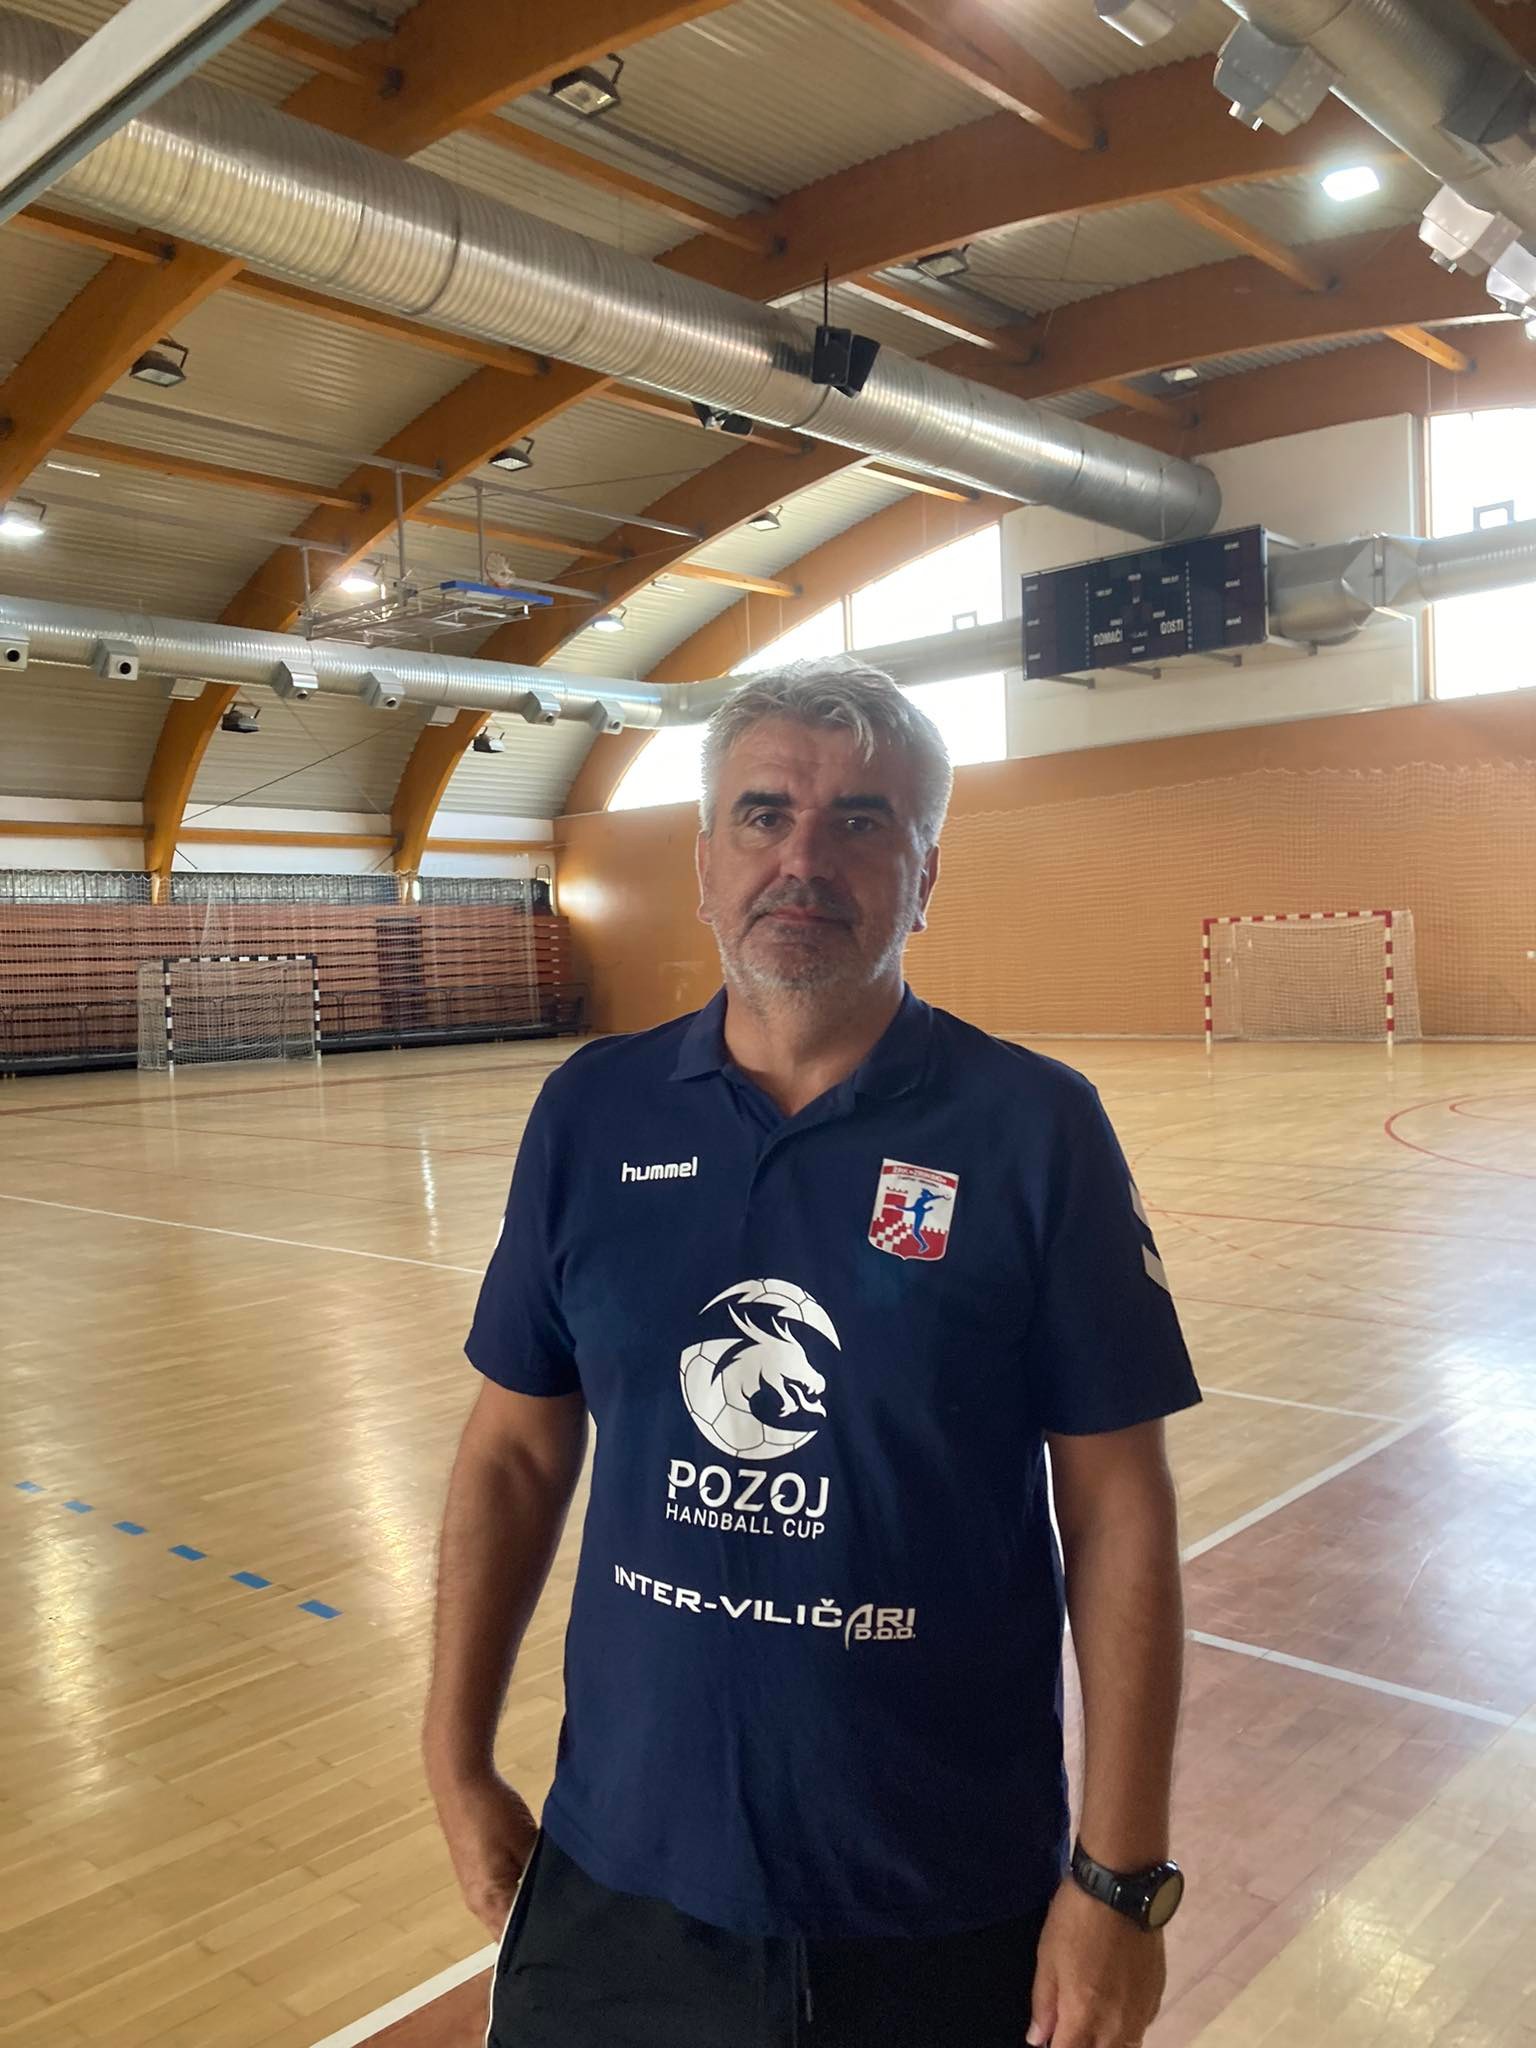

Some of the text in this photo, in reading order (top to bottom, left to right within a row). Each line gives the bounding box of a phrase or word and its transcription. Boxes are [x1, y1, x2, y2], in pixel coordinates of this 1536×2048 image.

[1160, 618, 1184, 635] GOSTI
[621, 1156, 698, 1183] hummel
[667, 1459, 830, 1519] POZOJ
[665, 1502, 825, 1540] HANDBALL CUP
